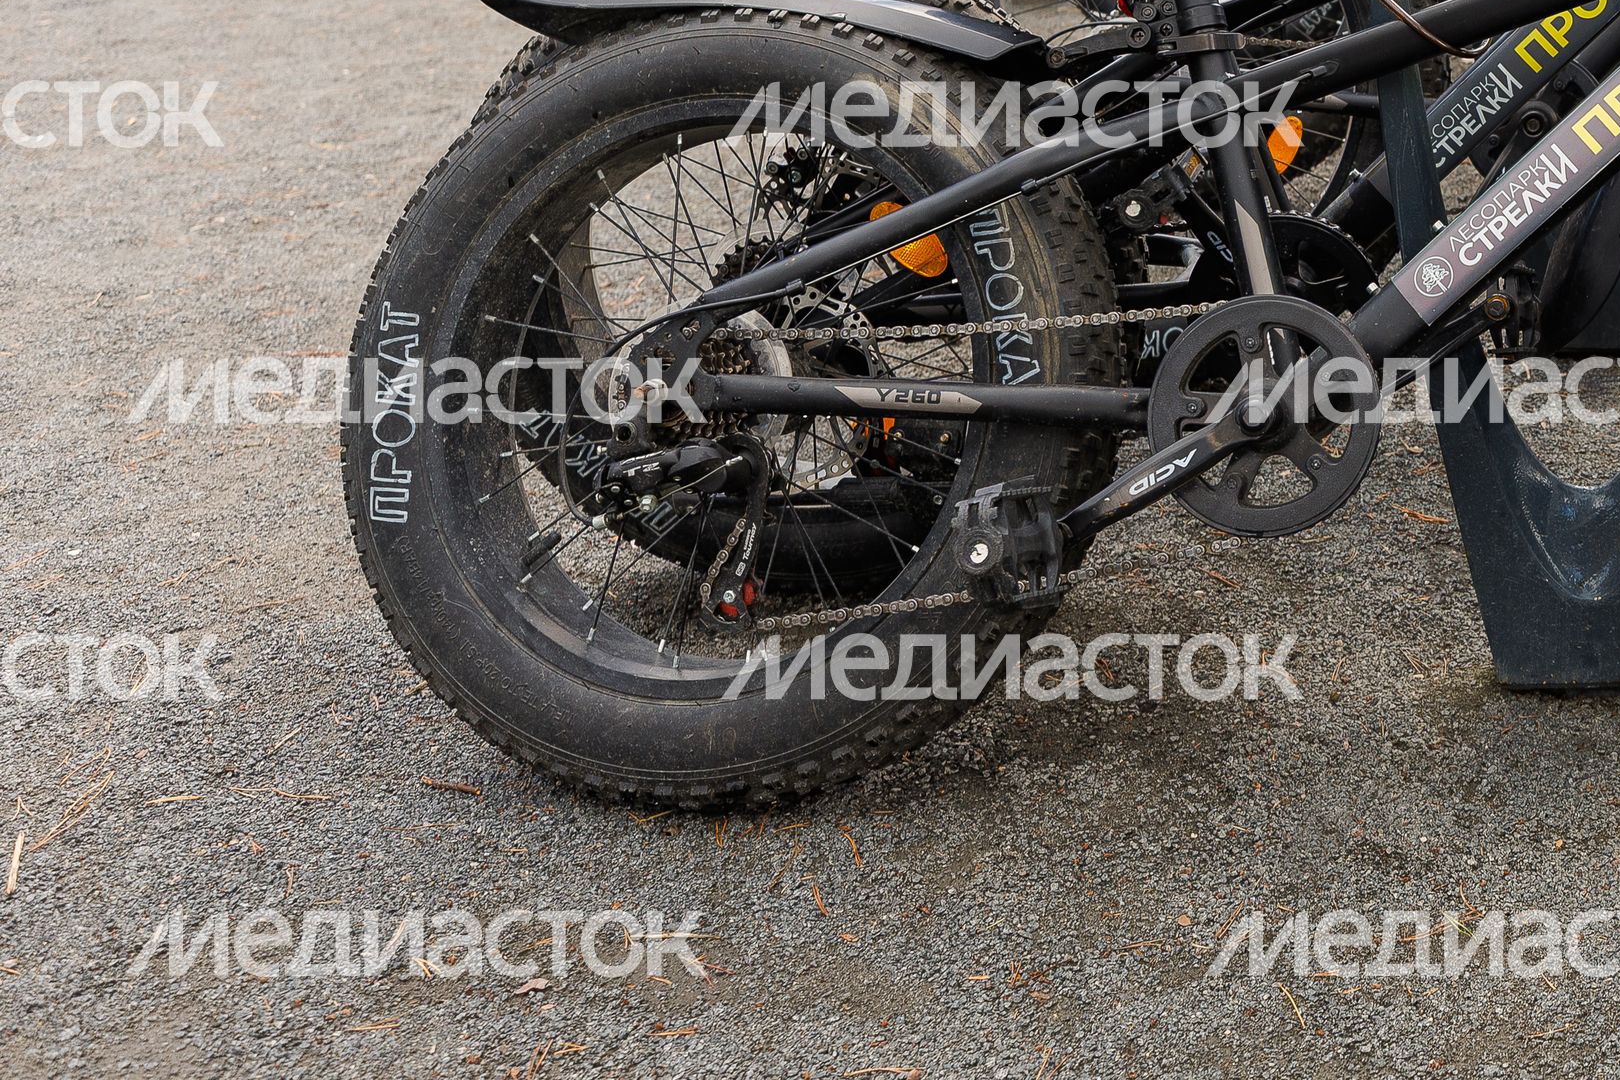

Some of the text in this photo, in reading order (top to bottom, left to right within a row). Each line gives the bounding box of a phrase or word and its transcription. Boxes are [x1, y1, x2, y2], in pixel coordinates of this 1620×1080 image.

[1458, 143, 1579, 267] СТРЕЛКИ
[969, 202, 1041, 386] ПРОКА
[369, 301, 420, 524] ПРОКАТ
[875, 387, 942, 405] Y260
[1128, 448, 1198, 496] ACID
